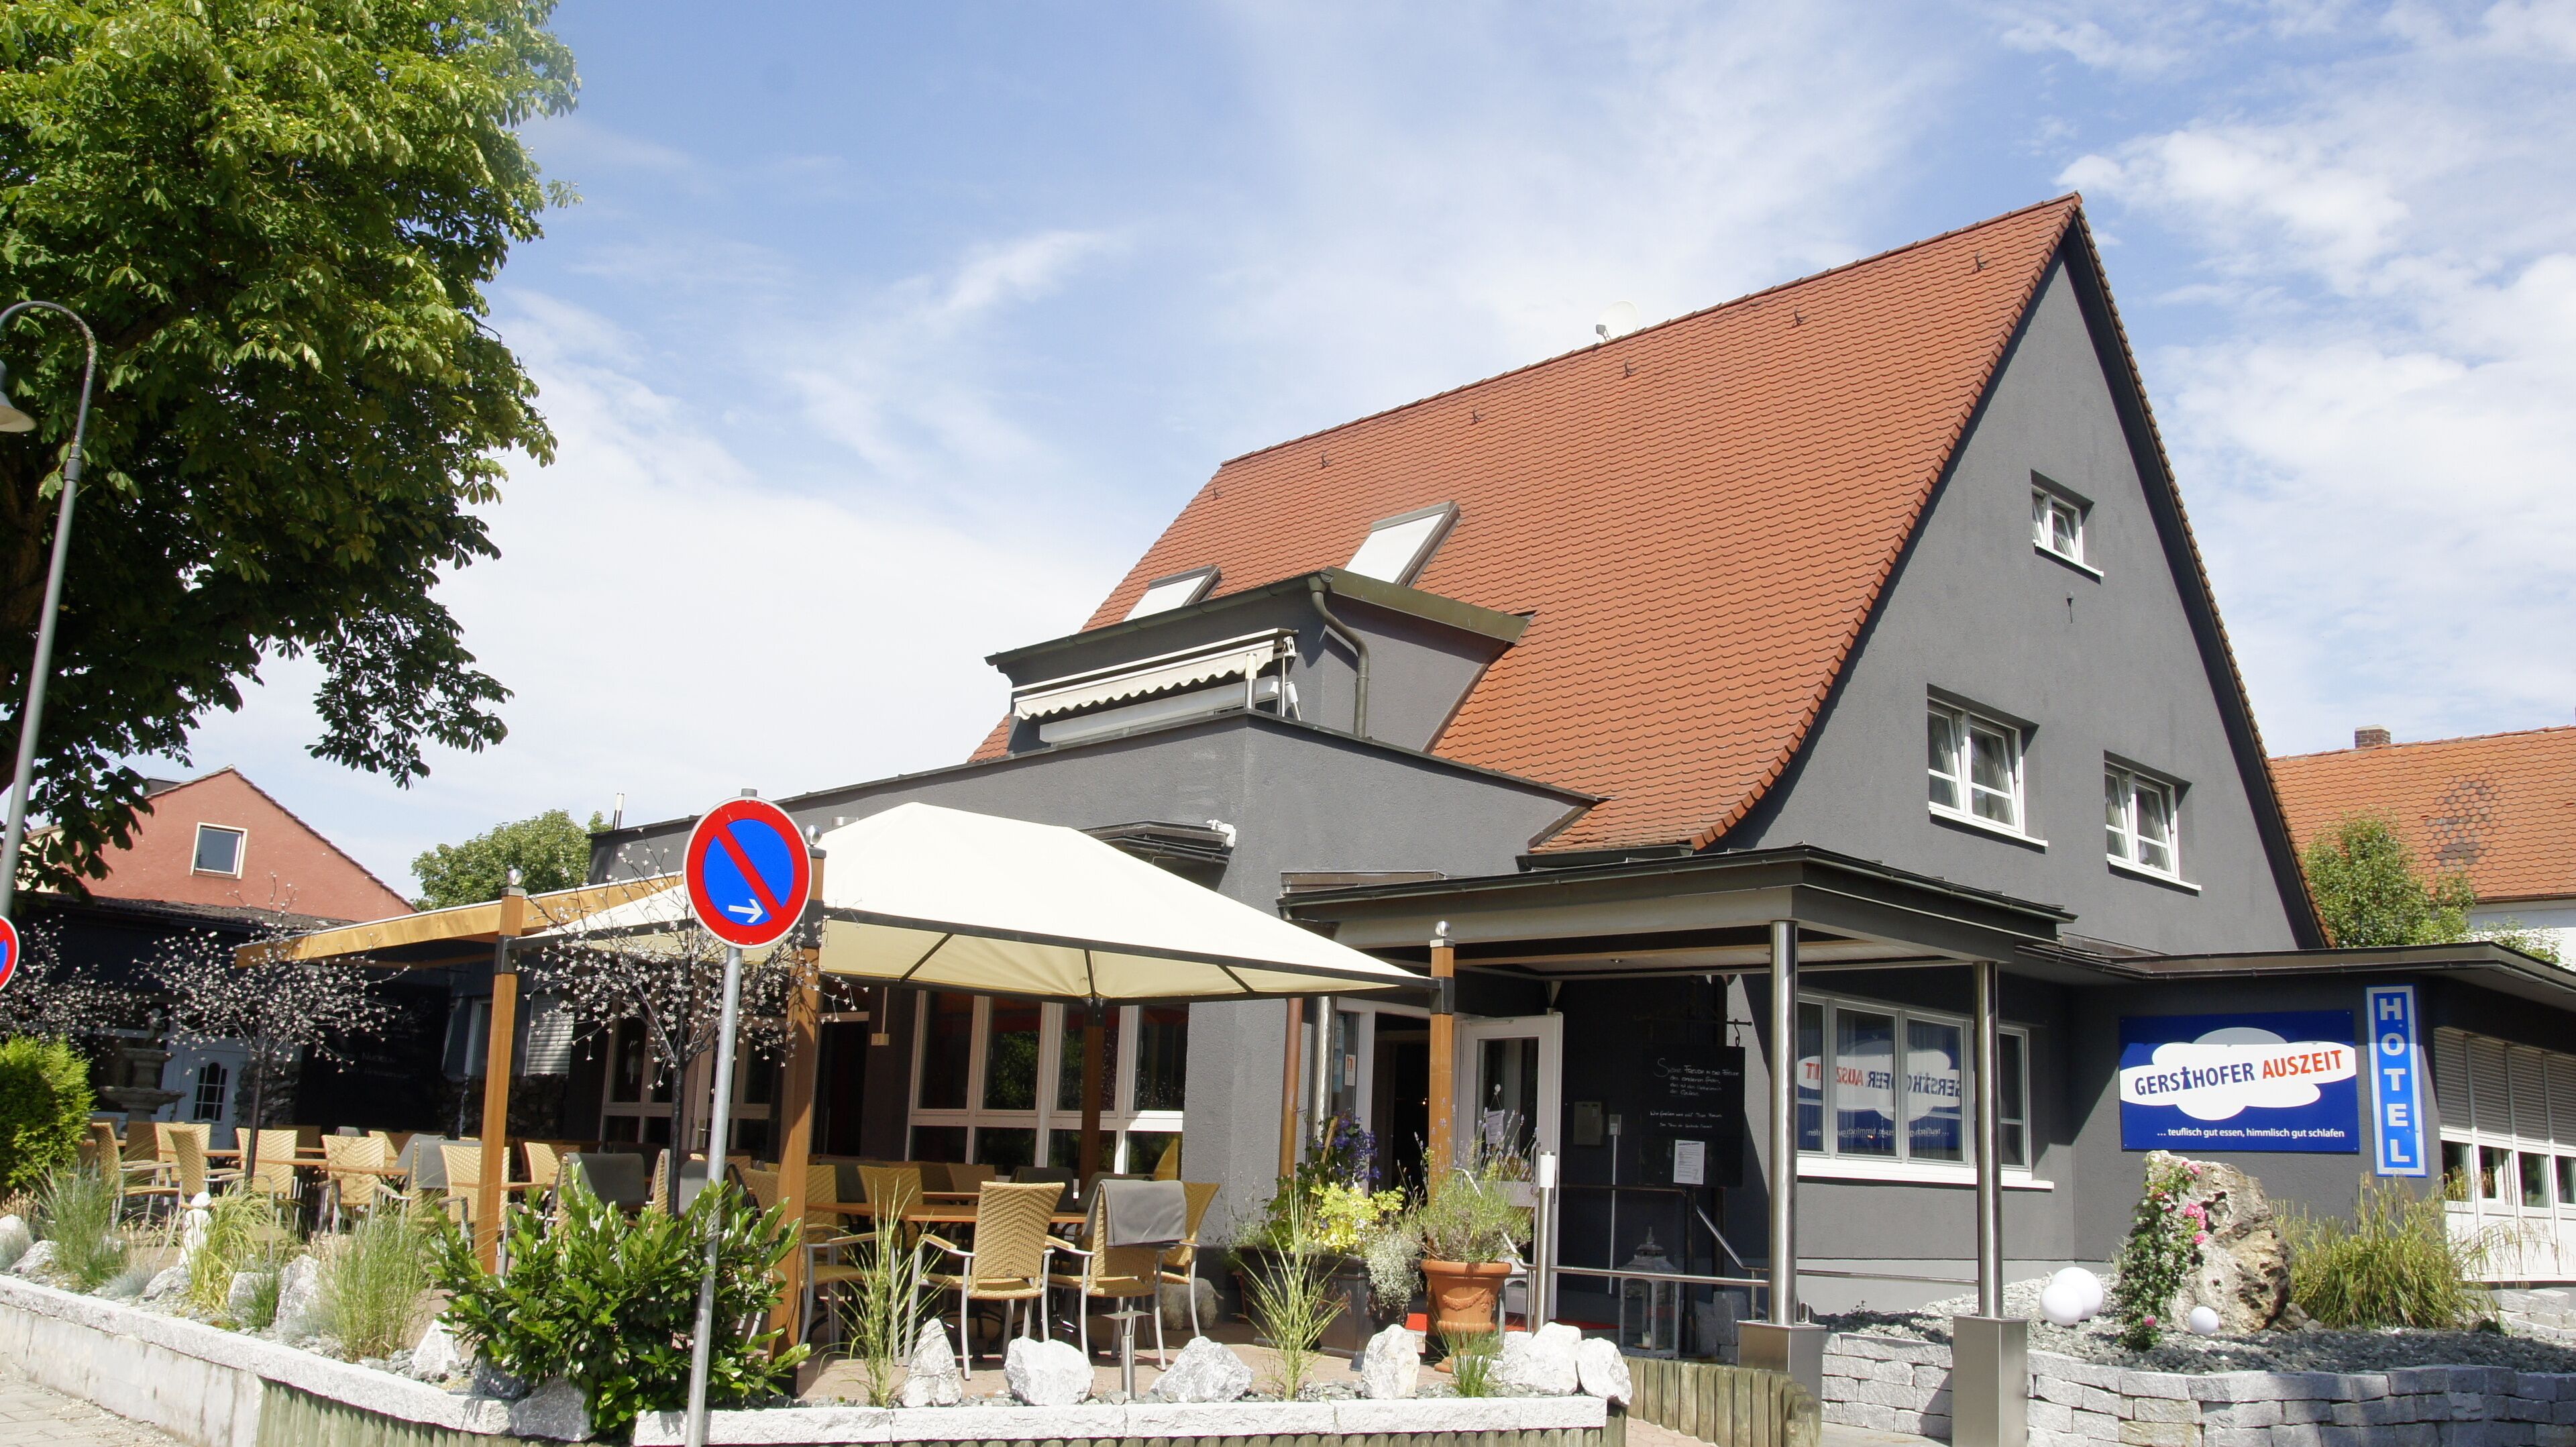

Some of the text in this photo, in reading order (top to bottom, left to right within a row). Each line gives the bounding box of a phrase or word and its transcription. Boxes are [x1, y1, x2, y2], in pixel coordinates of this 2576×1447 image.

[2135, 1050, 2343, 1095] GERSTHOFER AUSZEIT
[2379, 998, 2410, 1162] HOTEL
[2167, 1128, 2202, 1137] teuflisch
[2203, 1130, 2217, 1138] gut
[2246, 1128, 2289, 1138] himmlisch
[2292, 1130, 2306, 1139] gut
[2308, 1128, 2345, 1138] schlafen
